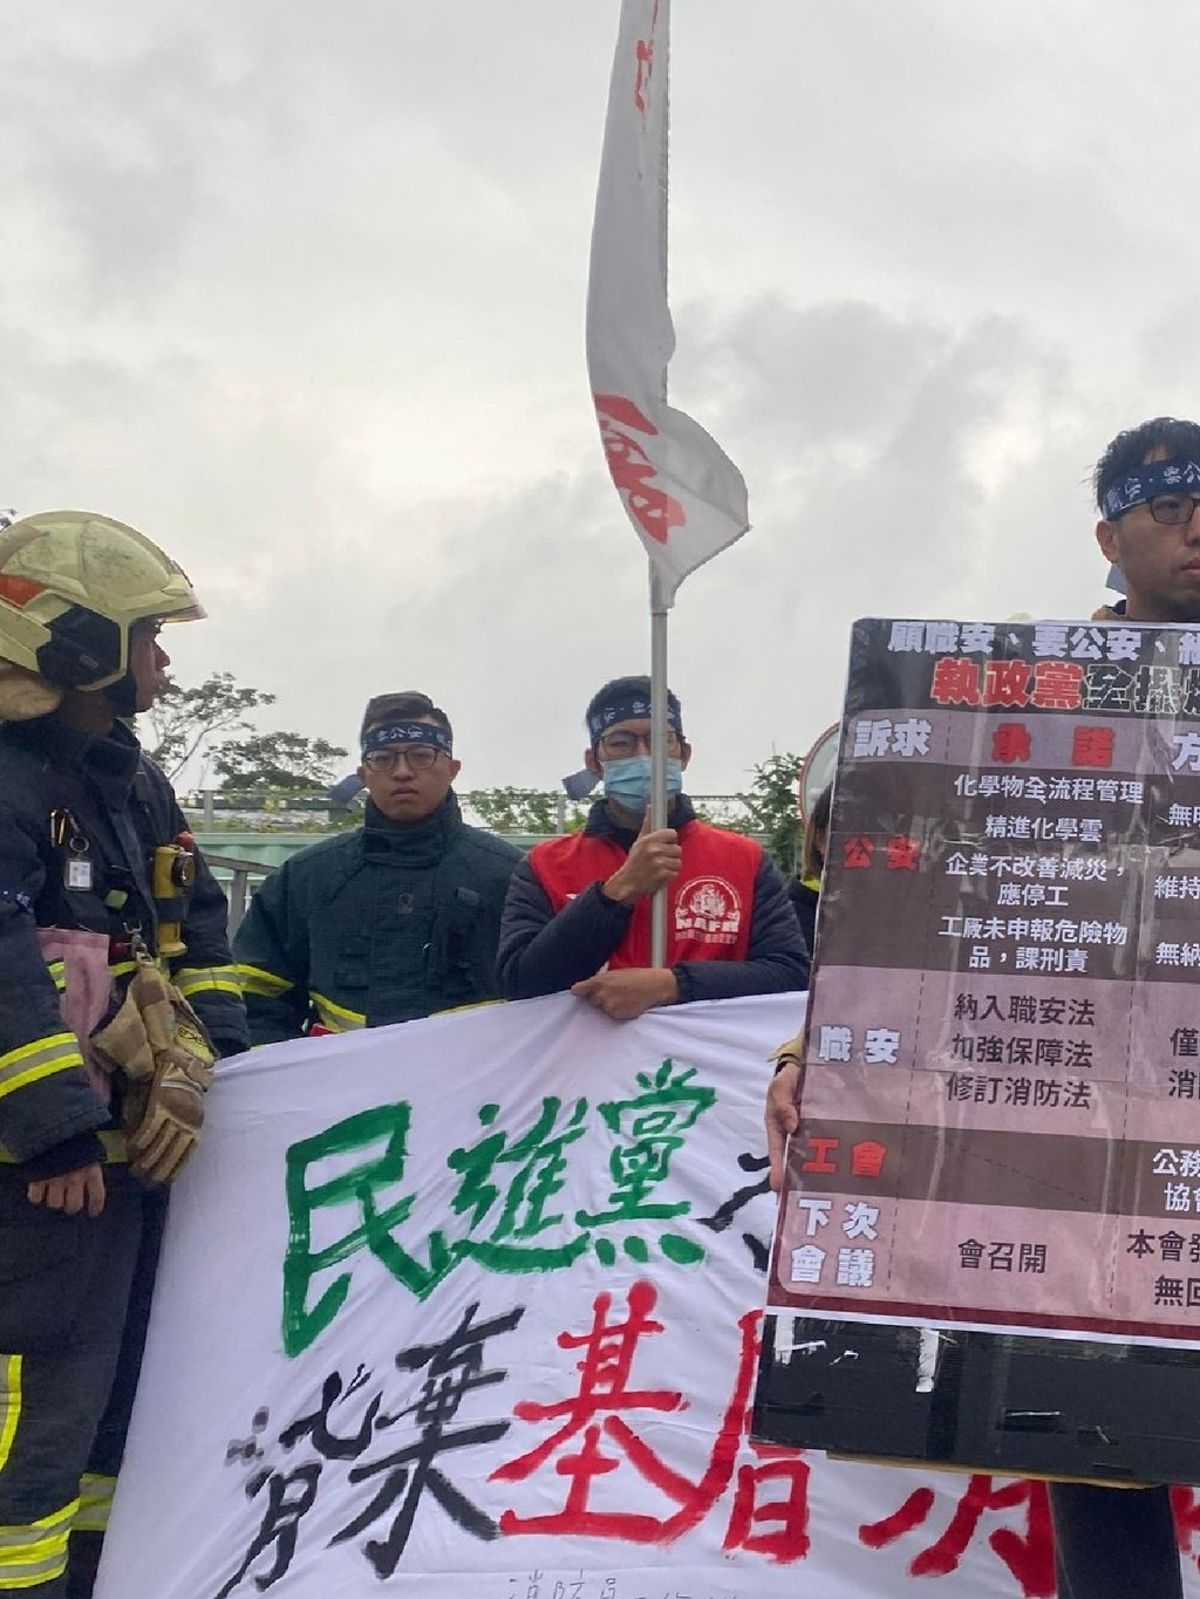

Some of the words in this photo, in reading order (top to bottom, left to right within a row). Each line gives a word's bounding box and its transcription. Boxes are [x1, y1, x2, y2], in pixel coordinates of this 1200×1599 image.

[852, 718, 932, 758] 訴求
[953, 774, 1145, 803] 化學物全流程管理
[985, 814, 1104, 843] 精進化學雲
[843, 835, 921, 870] 公安
[996, 882, 1069, 908] 應停工
[676, 916, 739, 933] NAFR
[952, 993, 1096, 1027] 納入職安法
[817, 1025, 901, 1065] 職安
[950, 1032, 1094, 1069] 加強保障法
[945, 1074, 1092, 1110] 修訂消防法
[802, 1136, 888, 1180] 工會
[797, 1199, 881, 1241] 下次
[790, 1243, 876, 1288] 會議
[956, 1238, 1047, 1274] 會召開
